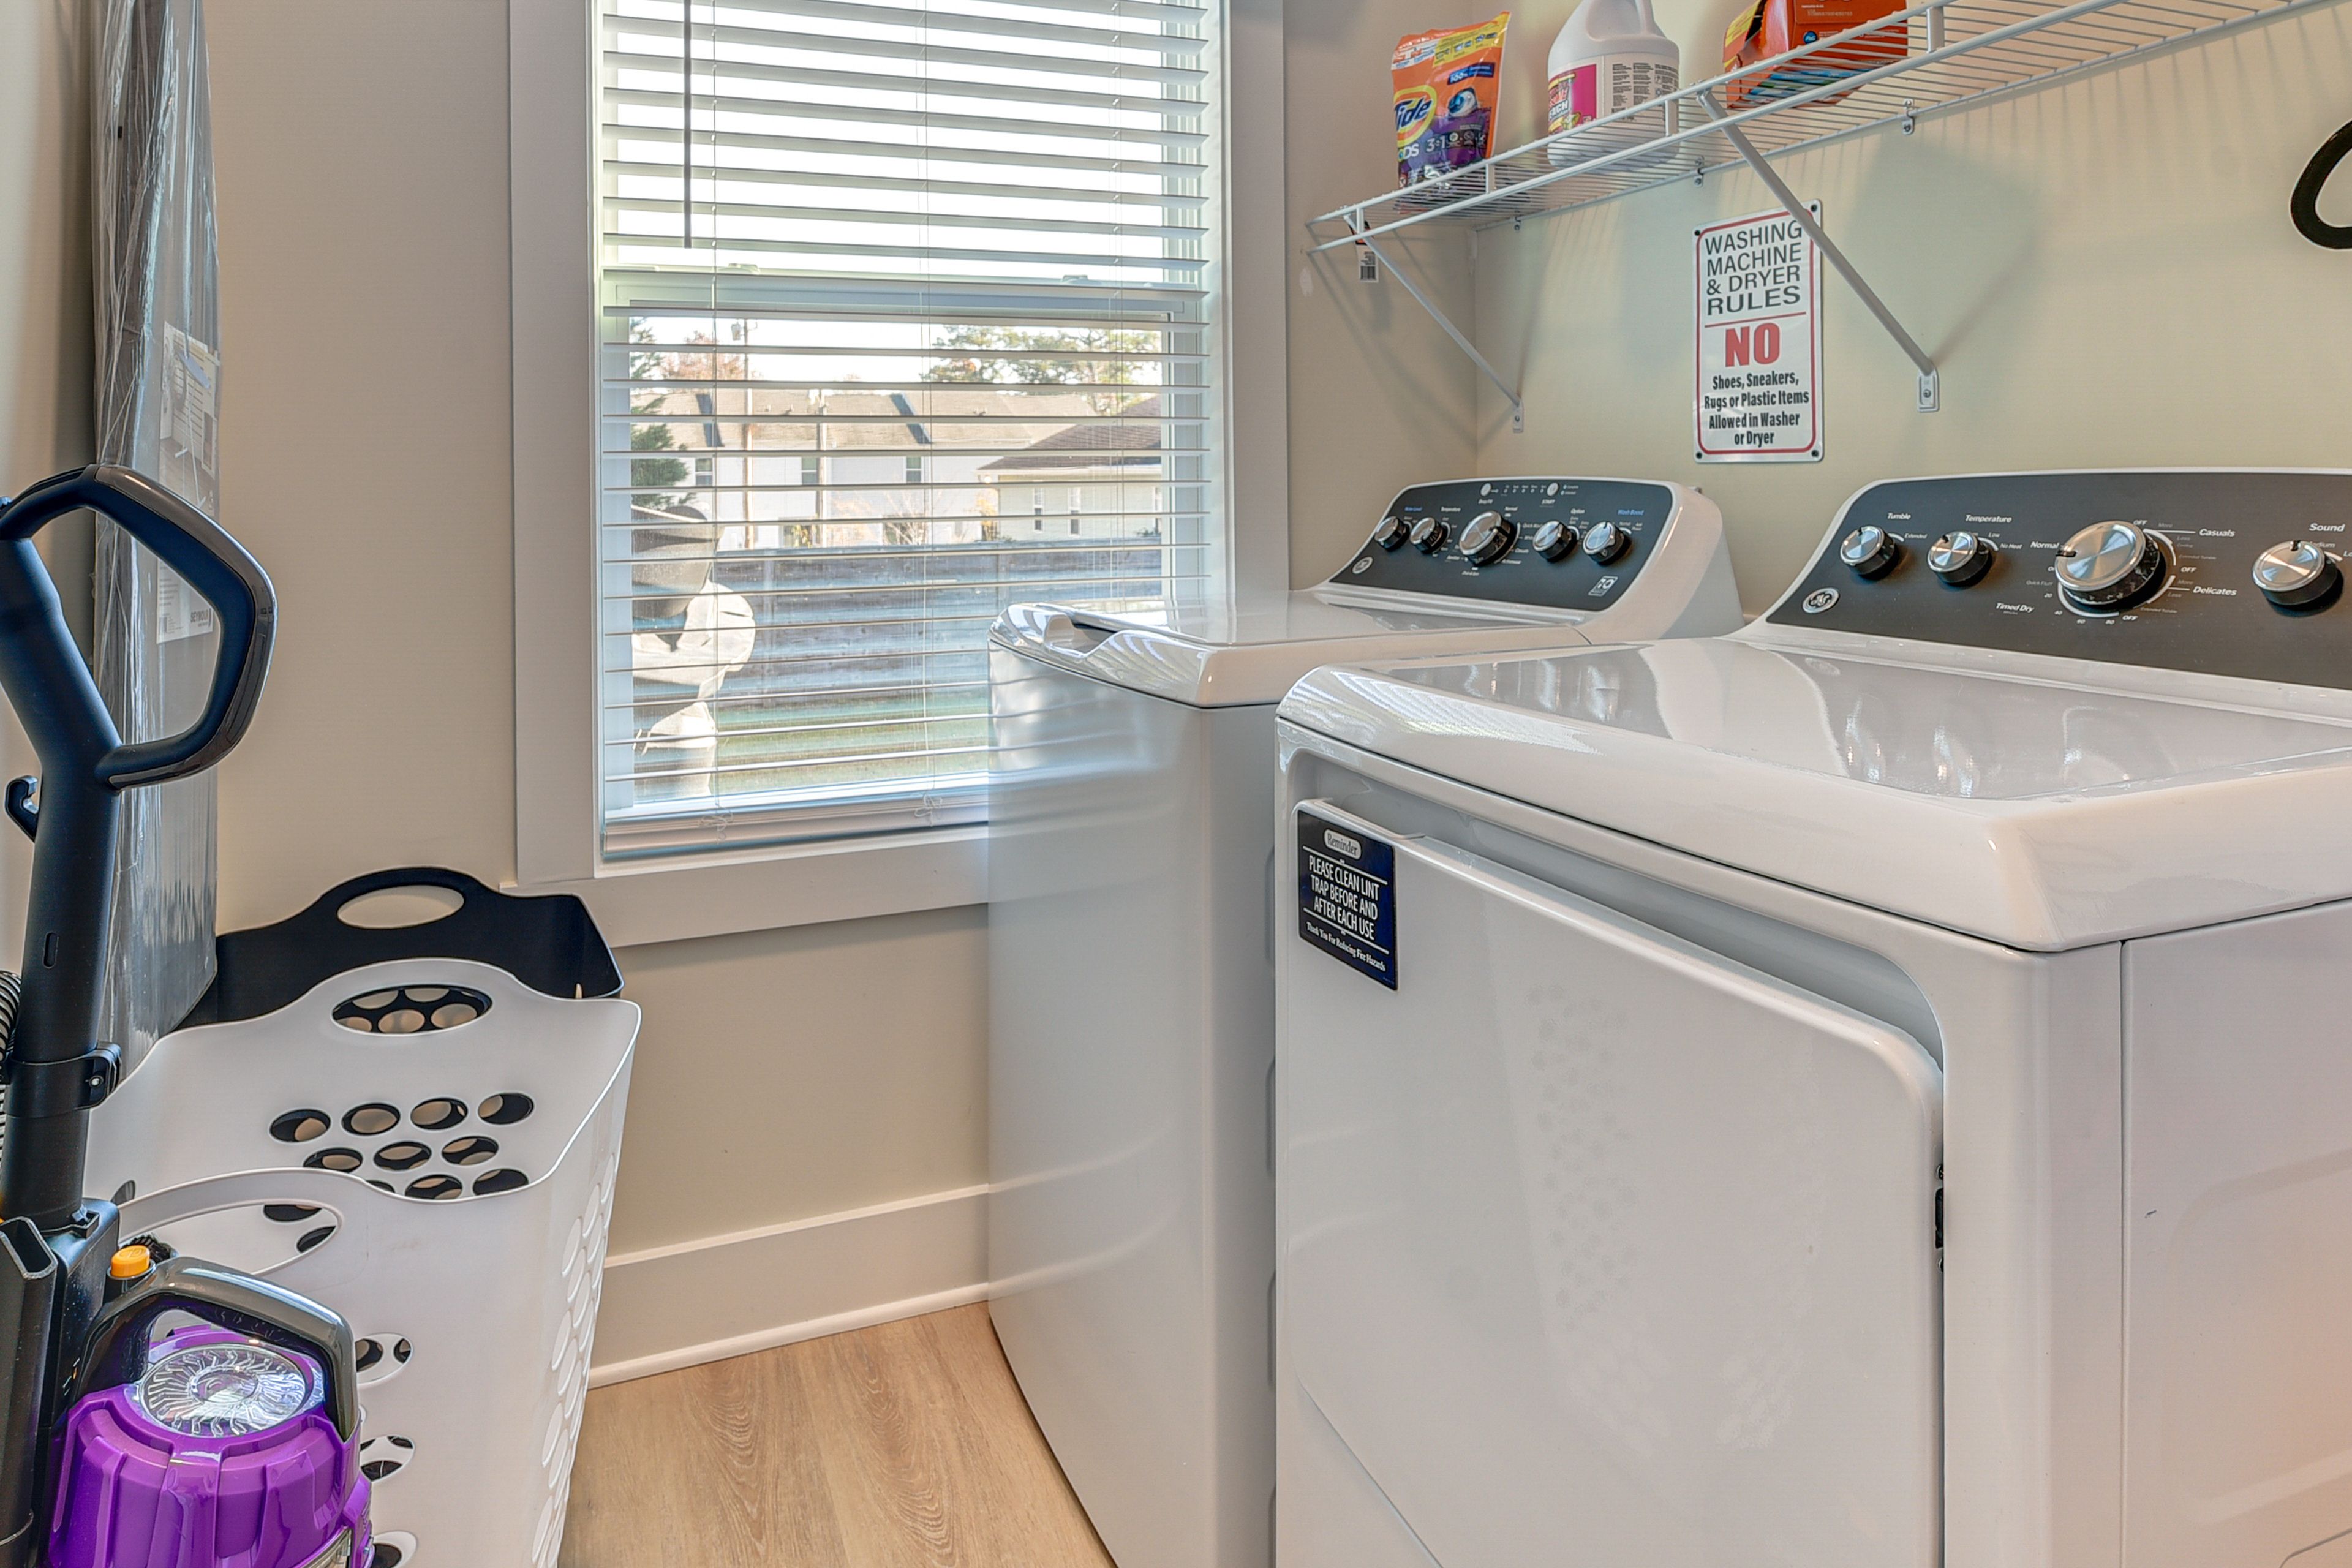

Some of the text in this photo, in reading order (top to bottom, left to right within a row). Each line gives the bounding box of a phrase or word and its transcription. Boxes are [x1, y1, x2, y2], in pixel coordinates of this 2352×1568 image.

[1394, 95, 1433, 131] Tide
[1705, 220, 1802, 255] WASHING
[1707, 242, 1802, 277] MACHINE
[1706, 265, 1800, 295] & DRYER
[1708, 285, 1801, 315] RULES
[1725, 322, 1781, 368] NO
[1713, 371, 1799, 390] Shoes, Sneakers,
[1705, 390, 1809, 412] Rugs or Plastic Items
[1709, 411, 1800, 429] Allowed in Washer
[1734, 431, 1775, 448] or Dryer
[1965, 514, 2013, 523] Temperature
[2309, 522, 2346, 532] Sound
[2199, 529, 2236, 537] Casuals
[2193, 586, 2237, 595] Delicates
[2021, 604, 2035, 612] Dry
[1327, 832, 1358, 856] Reminder
[1309, 855, 1379, 901] PLEASE CLEAN LINT
[1310, 874, 1378, 920] TRAP BEFORE AND
[1314, 895, 1375, 941] AFTER EACH USE
[1306, 921, 1319, 937] Thank
[1319, 928, 1328, 941] You
